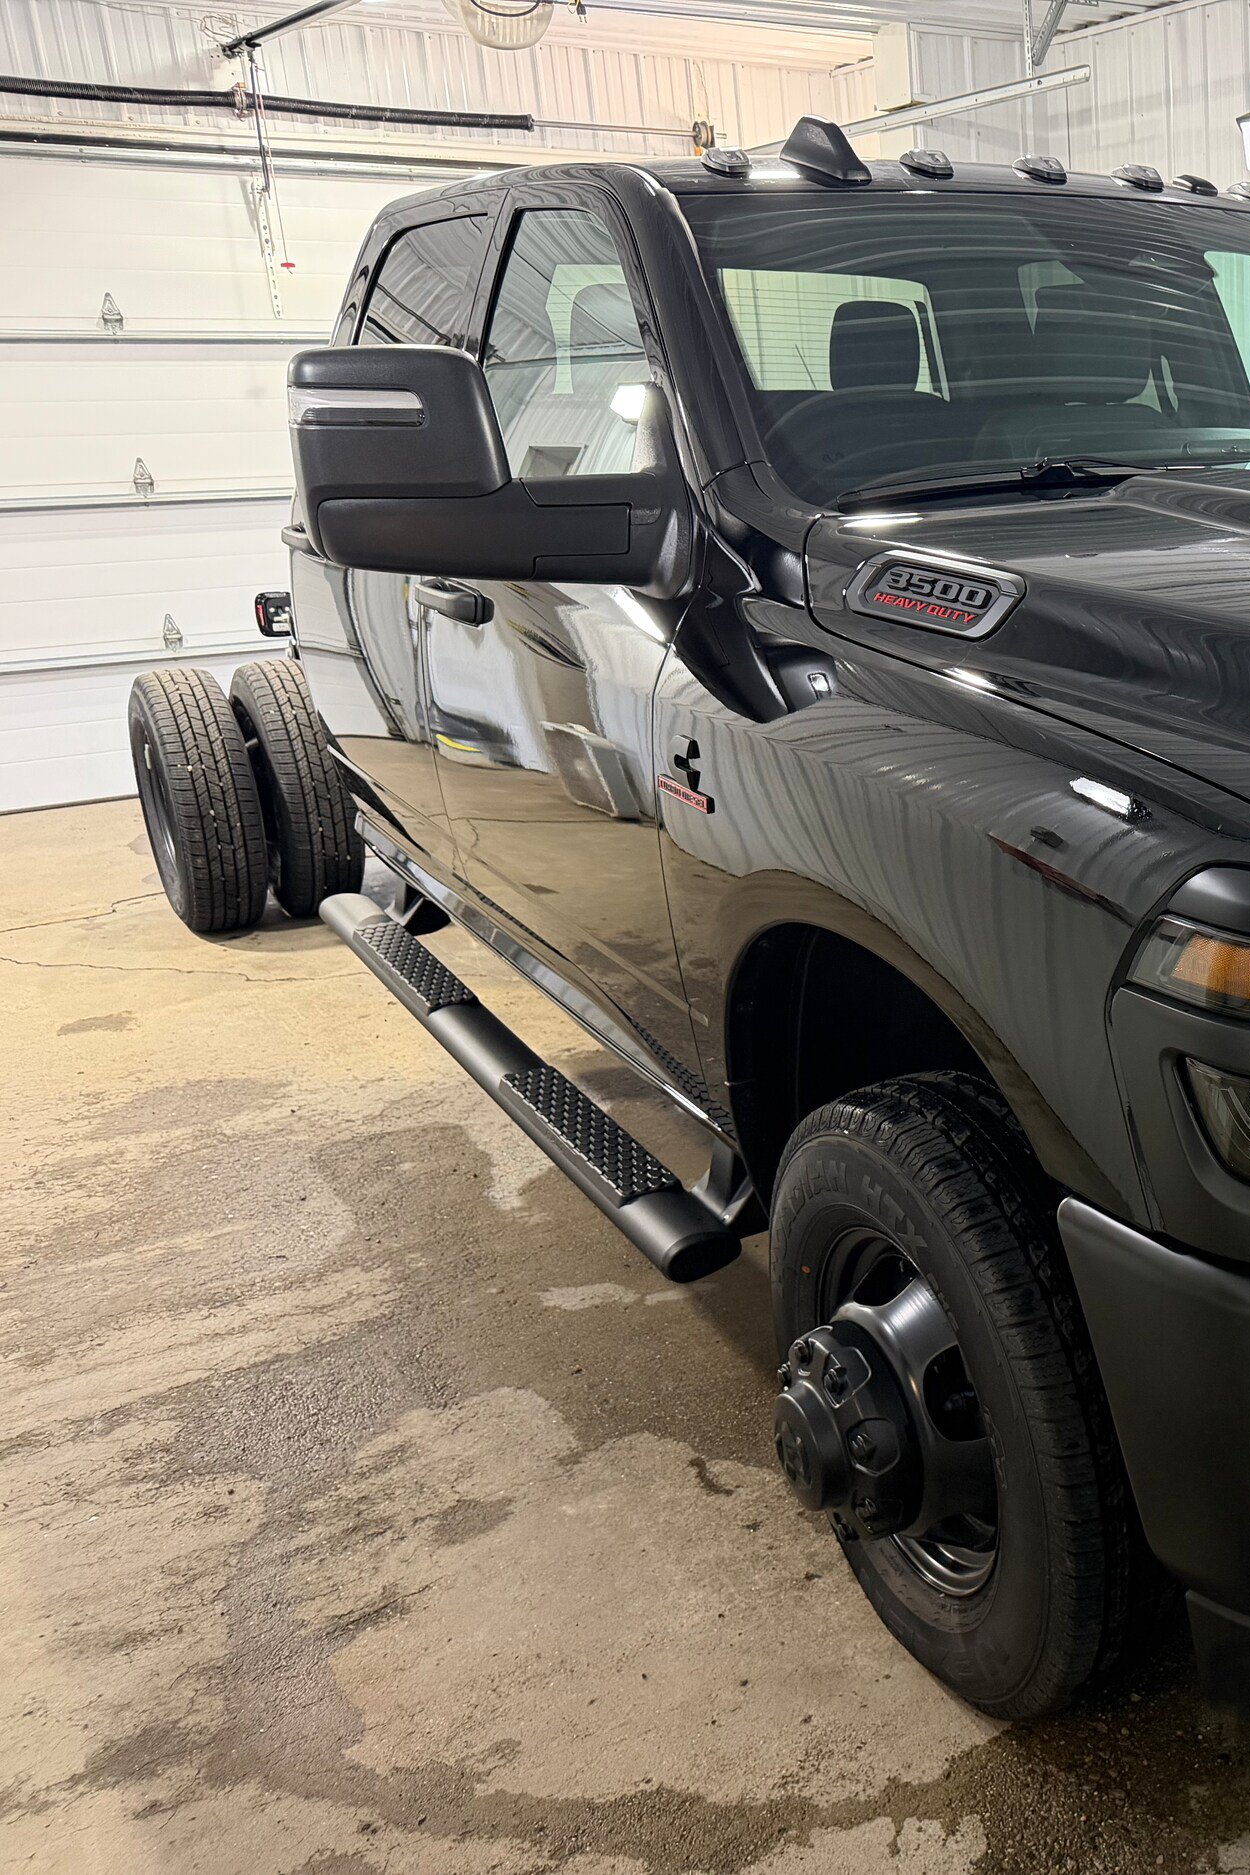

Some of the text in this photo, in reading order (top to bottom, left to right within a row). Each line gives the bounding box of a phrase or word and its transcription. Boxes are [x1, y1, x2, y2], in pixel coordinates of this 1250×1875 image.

[886, 569, 991, 609] 3500
[873, 592, 977, 624] HEAVY DUTY
